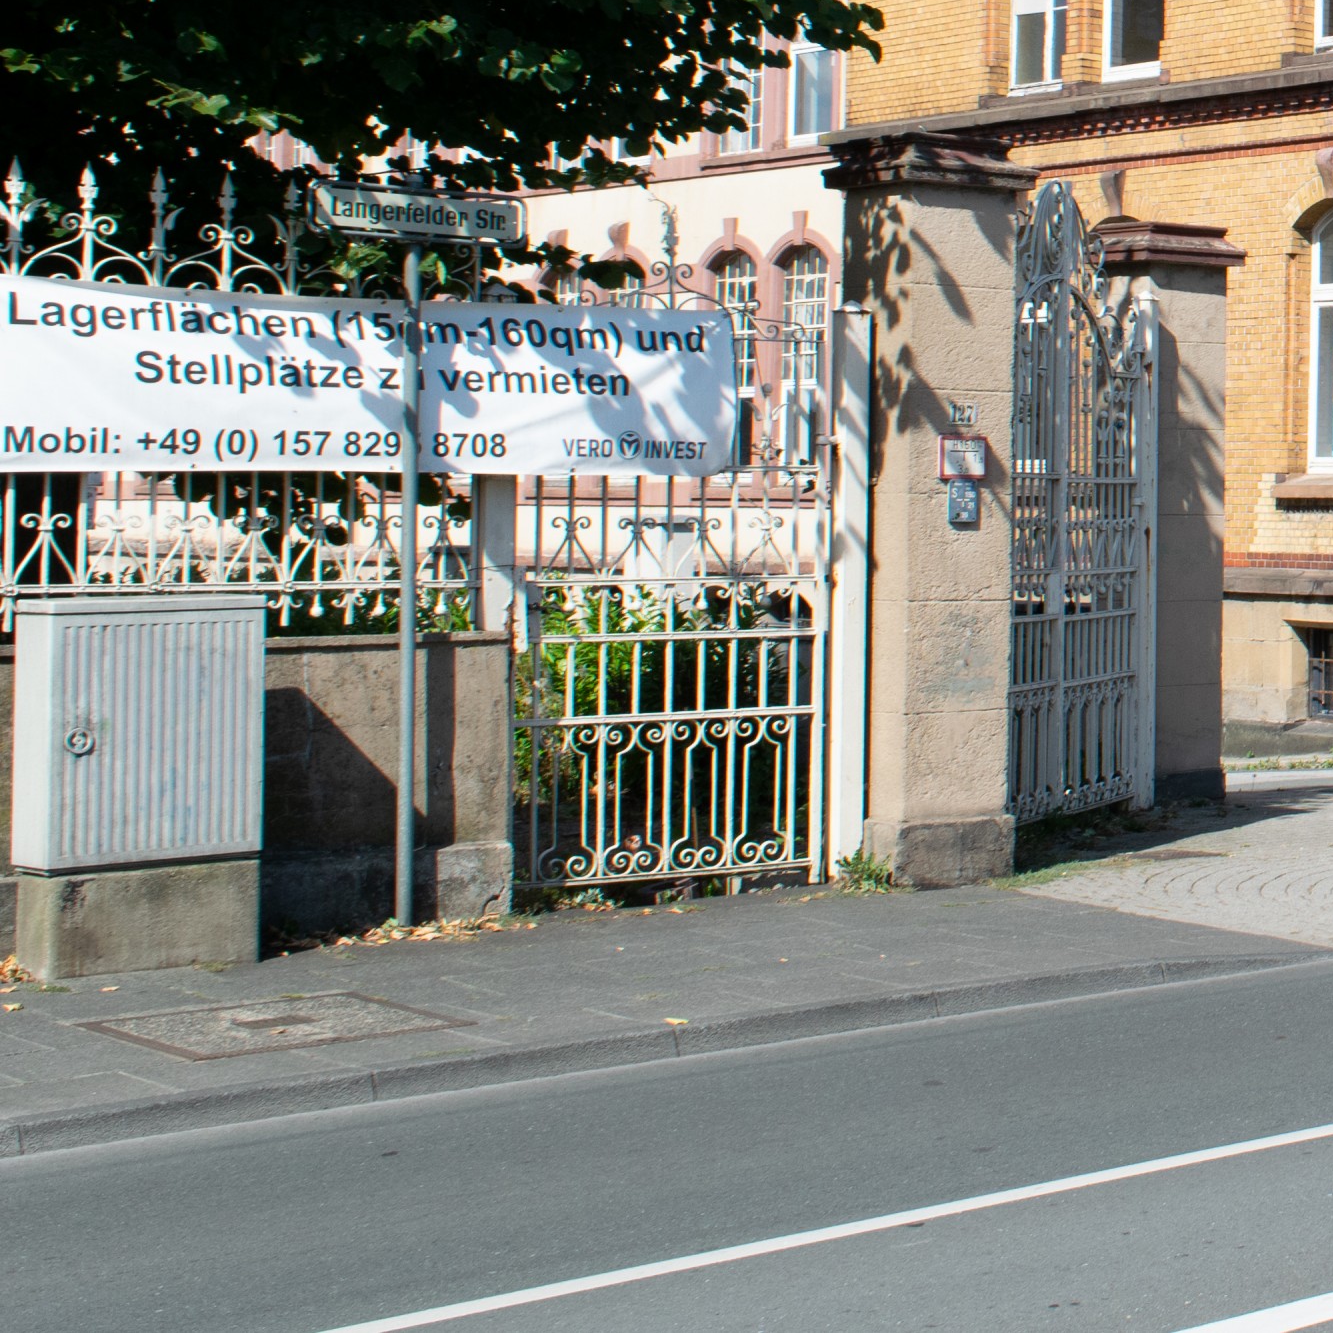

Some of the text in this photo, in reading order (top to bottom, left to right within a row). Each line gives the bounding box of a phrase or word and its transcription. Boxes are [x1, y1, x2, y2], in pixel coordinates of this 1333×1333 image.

[332, 196, 507, 231] Langerfelder Str.
[8, 291, 705, 358] Lagerflächen (15m-160qm) und
[136, 350, 365, 394] Stellplätze
[438, 365, 630, 396] vermieten
[950, 403, 973, 423] 127
[4, 425, 507, 462] Mobil: +49 (0) 157 829 8708
[562, 438, 707, 459] VERO INVEST
